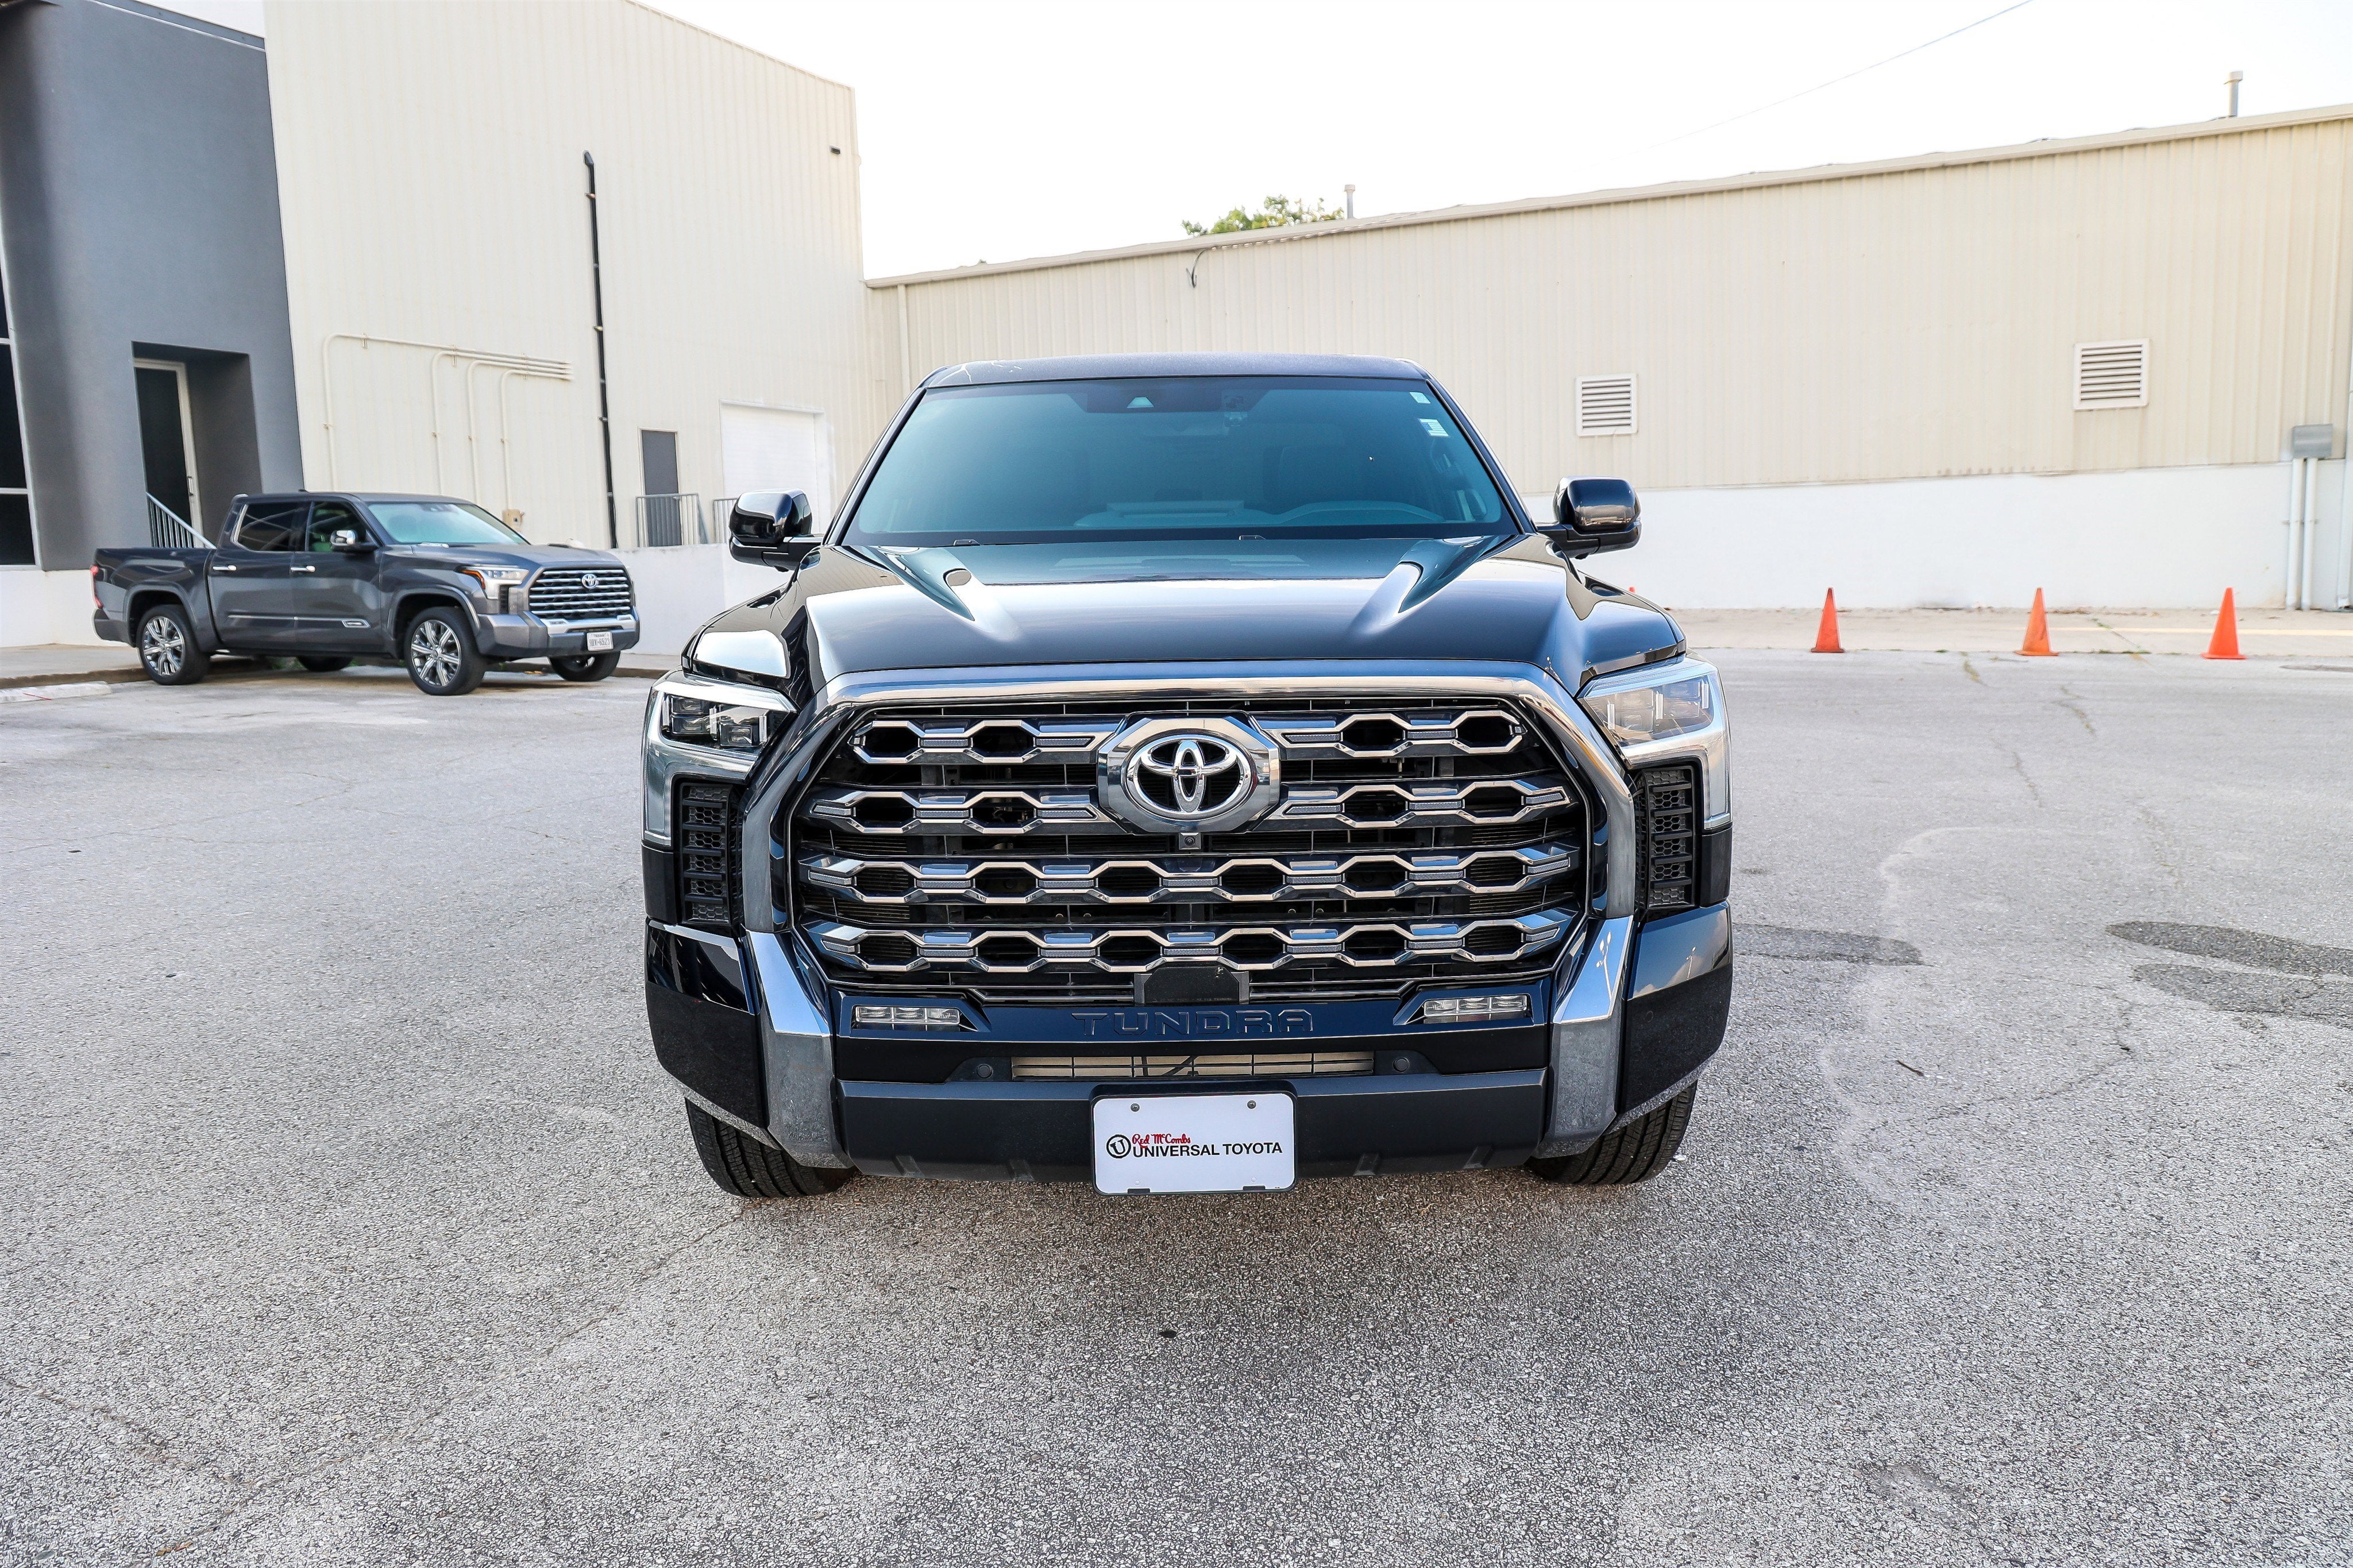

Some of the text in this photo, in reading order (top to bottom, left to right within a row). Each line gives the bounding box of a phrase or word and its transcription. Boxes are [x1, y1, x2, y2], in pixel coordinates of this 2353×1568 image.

[1071, 1009, 1313, 1035] TUNDRA
[1132, 1133, 1191, 1148] Red McCombs
[1133, 1142, 1283, 1157] UNIVERSAL TOYOTA
